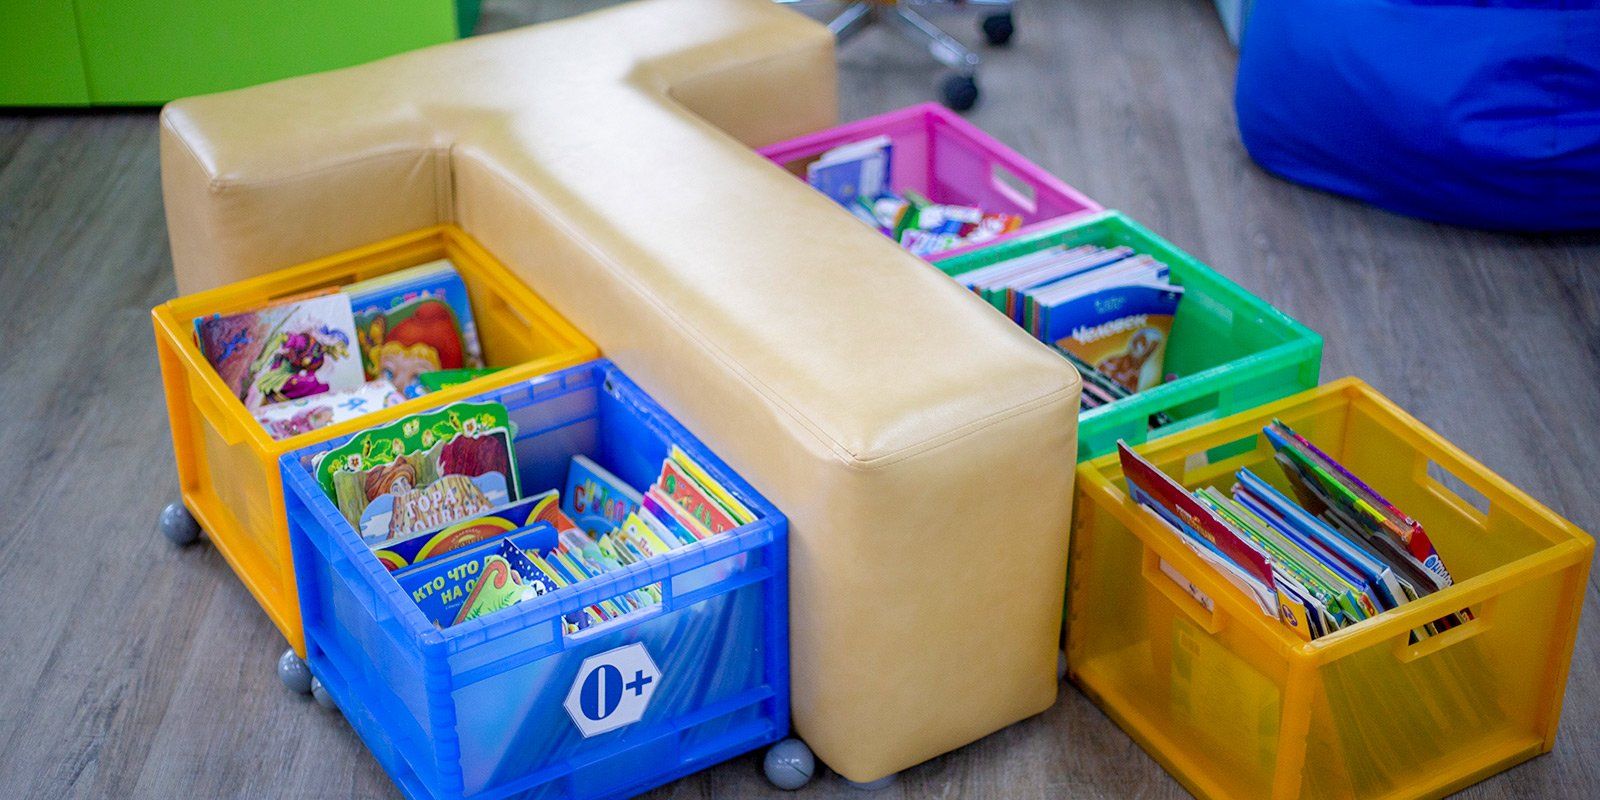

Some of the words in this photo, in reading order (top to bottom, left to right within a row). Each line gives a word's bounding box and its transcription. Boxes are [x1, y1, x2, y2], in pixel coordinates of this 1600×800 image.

[1072, 313, 1148, 345] Человек
[406, 488, 456, 518] ГОРА
[412, 576, 446, 604] КТО
[447, 560, 480, 581] ЧТО
[441, 585, 463, 605] НА
[580, 664, 653, 722] 0+
